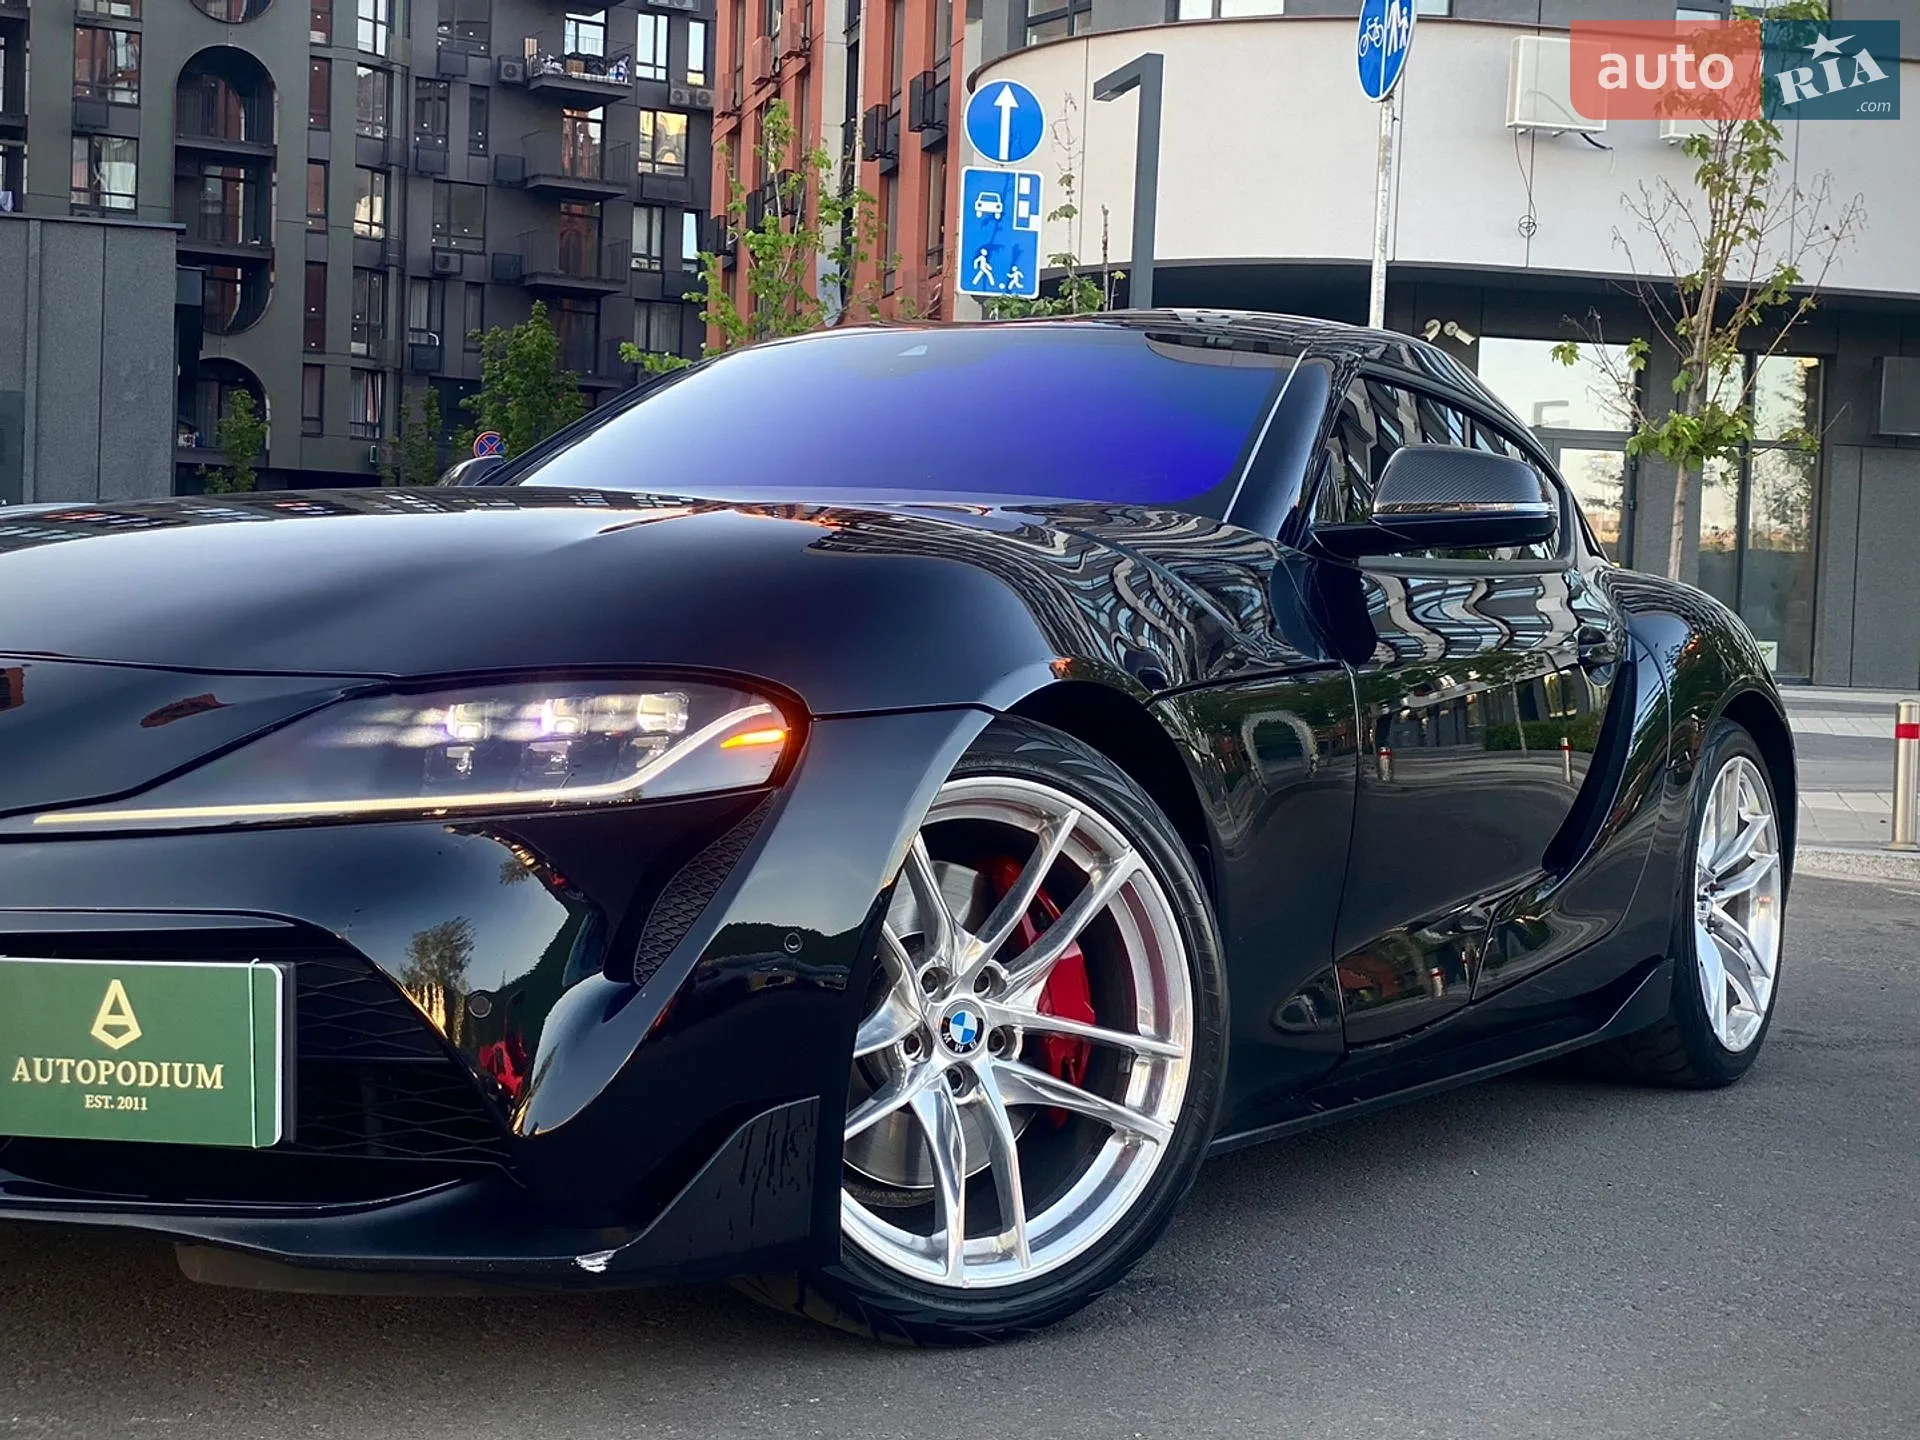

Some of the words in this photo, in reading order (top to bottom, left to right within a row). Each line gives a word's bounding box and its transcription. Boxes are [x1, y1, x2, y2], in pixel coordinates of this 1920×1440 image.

[12, 1057, 224, 1090] AUTOPODIUM
[84, 1094, 115, 1109] EST.
[117, 1096, 148, 1111] 2011
